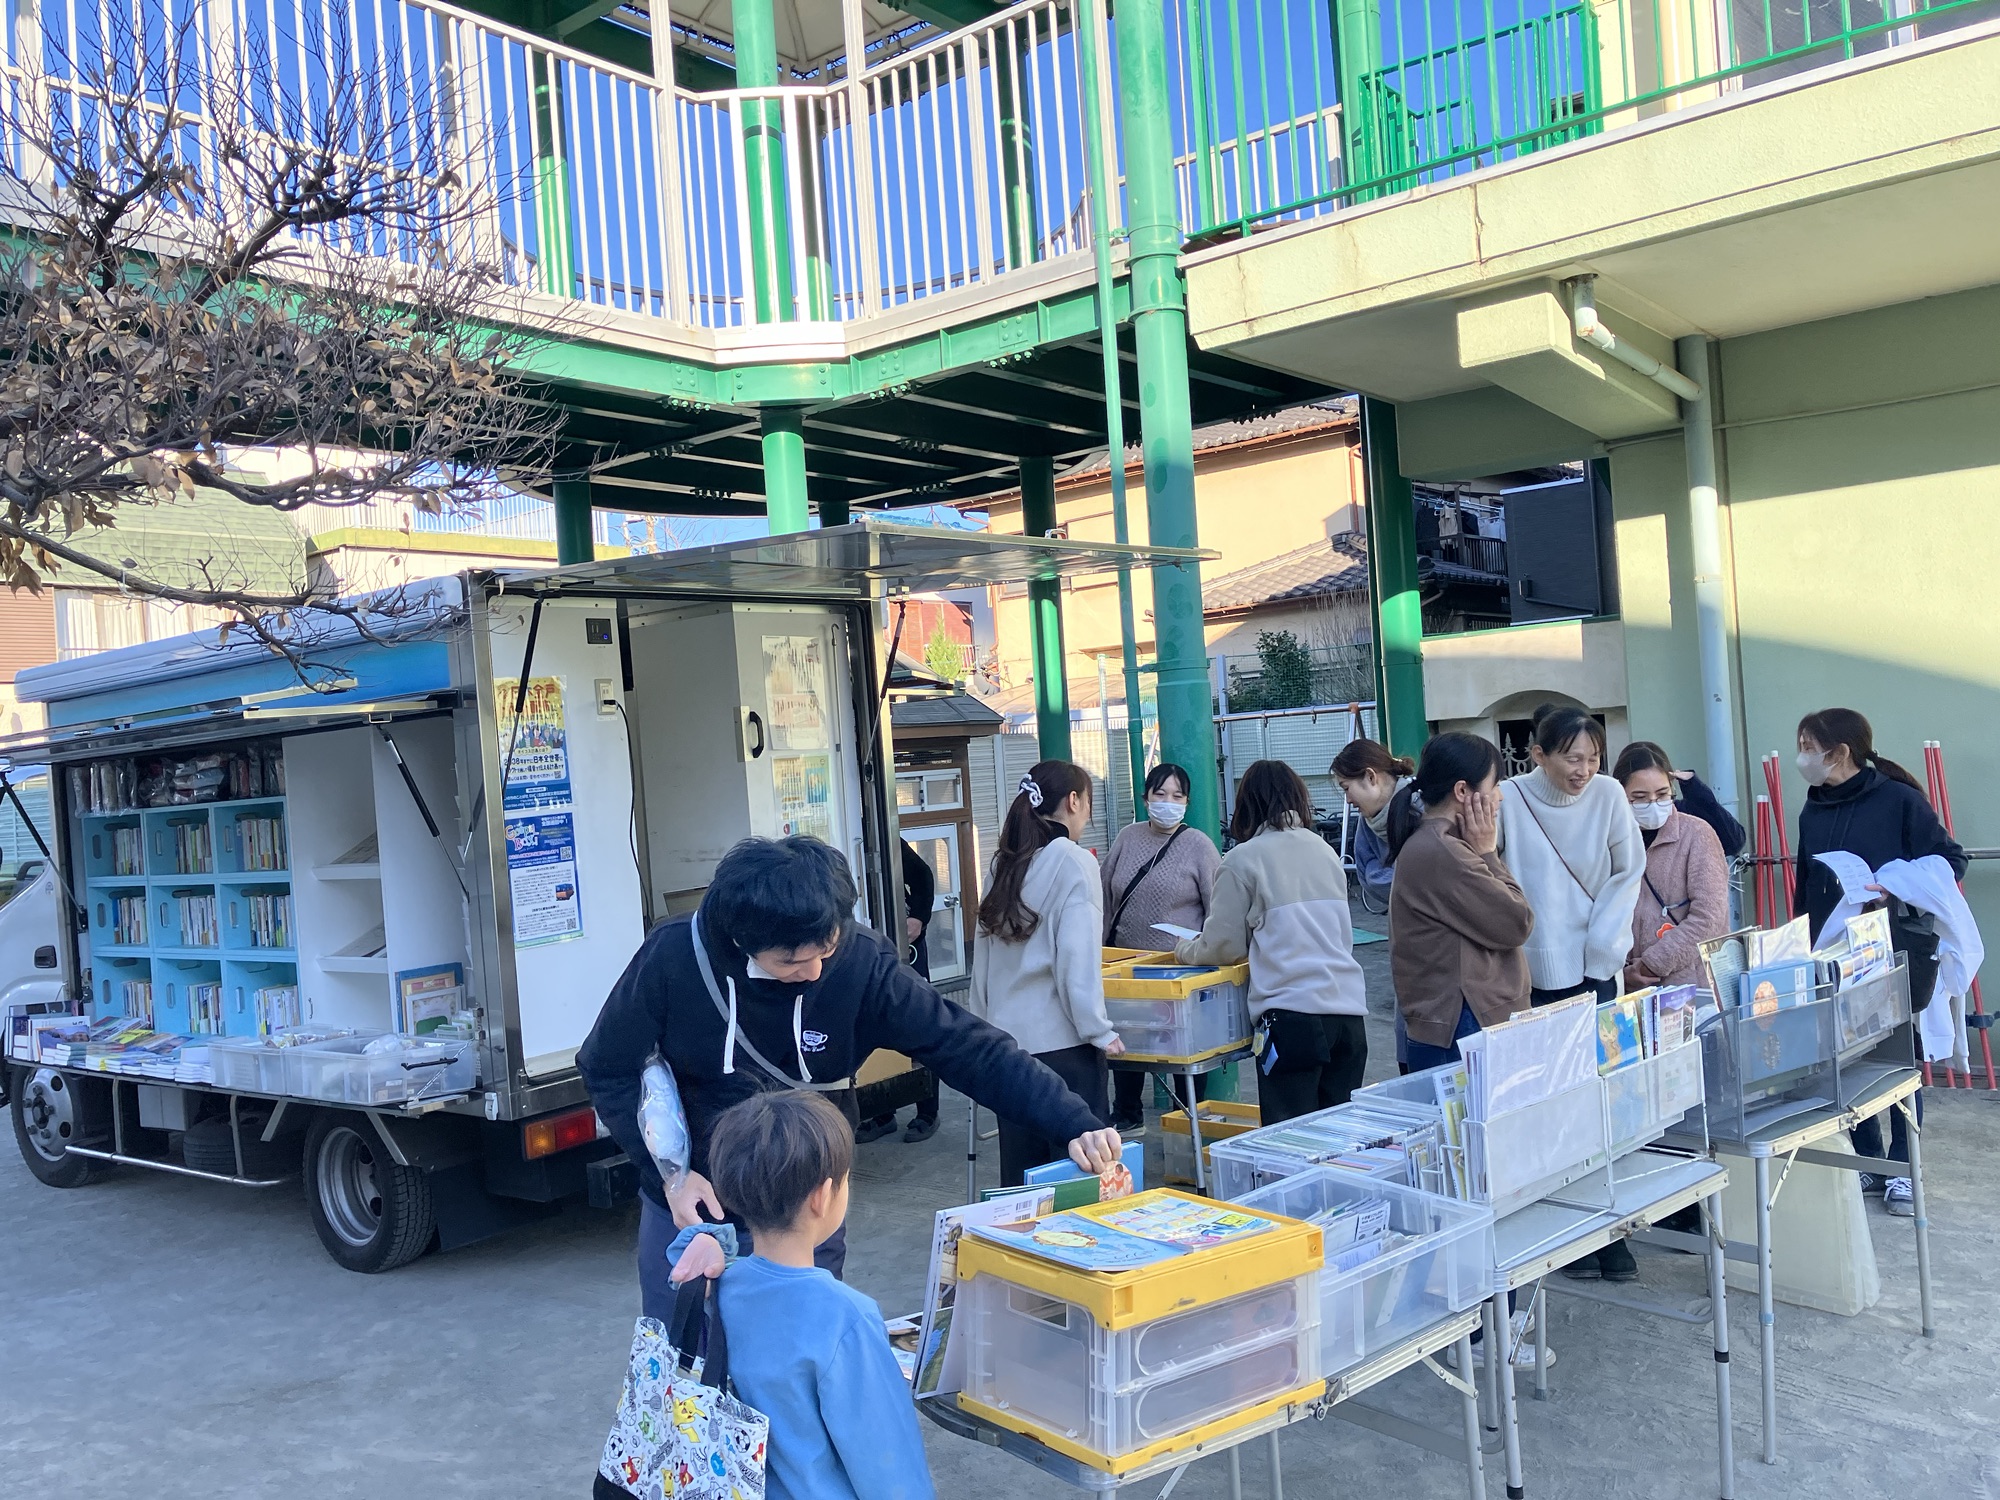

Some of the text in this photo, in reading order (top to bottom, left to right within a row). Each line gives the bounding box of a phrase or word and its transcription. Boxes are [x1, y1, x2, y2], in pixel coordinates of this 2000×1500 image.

[504, 754, 563, 766] 238年までに日本全世帯に
